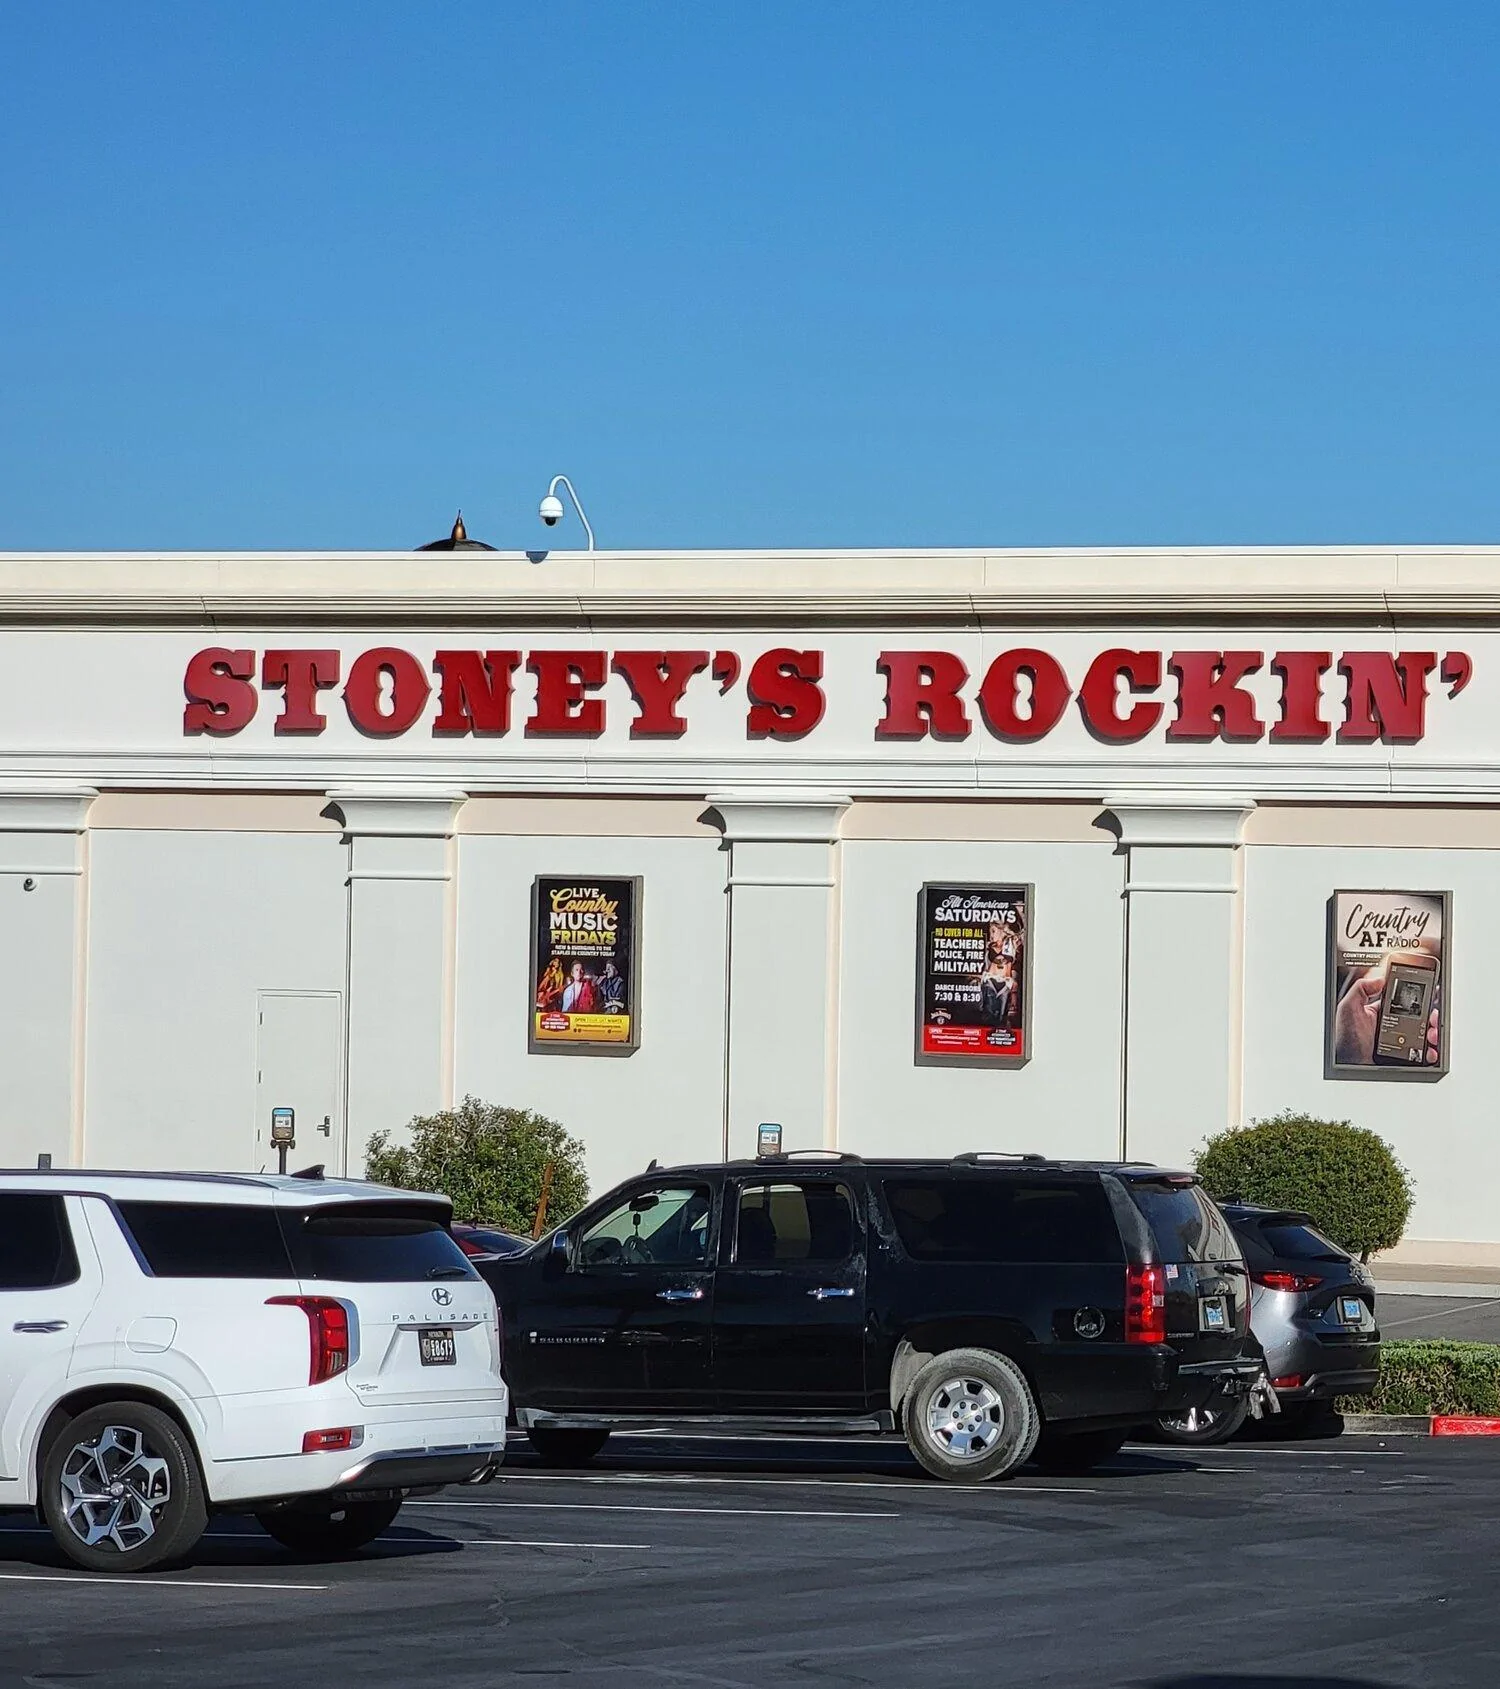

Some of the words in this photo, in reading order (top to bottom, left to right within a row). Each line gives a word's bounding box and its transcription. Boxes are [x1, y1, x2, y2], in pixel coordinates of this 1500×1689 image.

[184, 647, 827, 740] STONEY'S
[875, 648, 1473, 746] ROCKIN'
[573, 888, 599, 898] LIVE
[550, 888, 618, 917] Country
[942, 895, 963, 908] All
[963, 895, 1009, 909] American
[550, 912, 618, 931] MUSIC
[935, 907, 1016, 924] SATURDAYS
[1346, 903, 1430, 939] Country
[551, 930, 616, 946] FRIDAYS
[944, 928, 961, 937] COVER
[962, 929, 972, 937] FOR
[974, 929, 984, 938] ALL
[1359, 931, 1387, 947] AF
[1387, 937, 1420, 948] RADIO
[934, 938, 984, 950] TEACHERS
[934, 950, 965, 960] POLICE,
[966, 951, 984, 960] FIRE
[934, 961, 984, 973] MILITARY
[935, 992, 953, 1000] 7:30
[954, 992, 961, 1002] &
[963, 993, 981, 1002] 8:30
[392, 1313, 489, 1322] PALISADE
